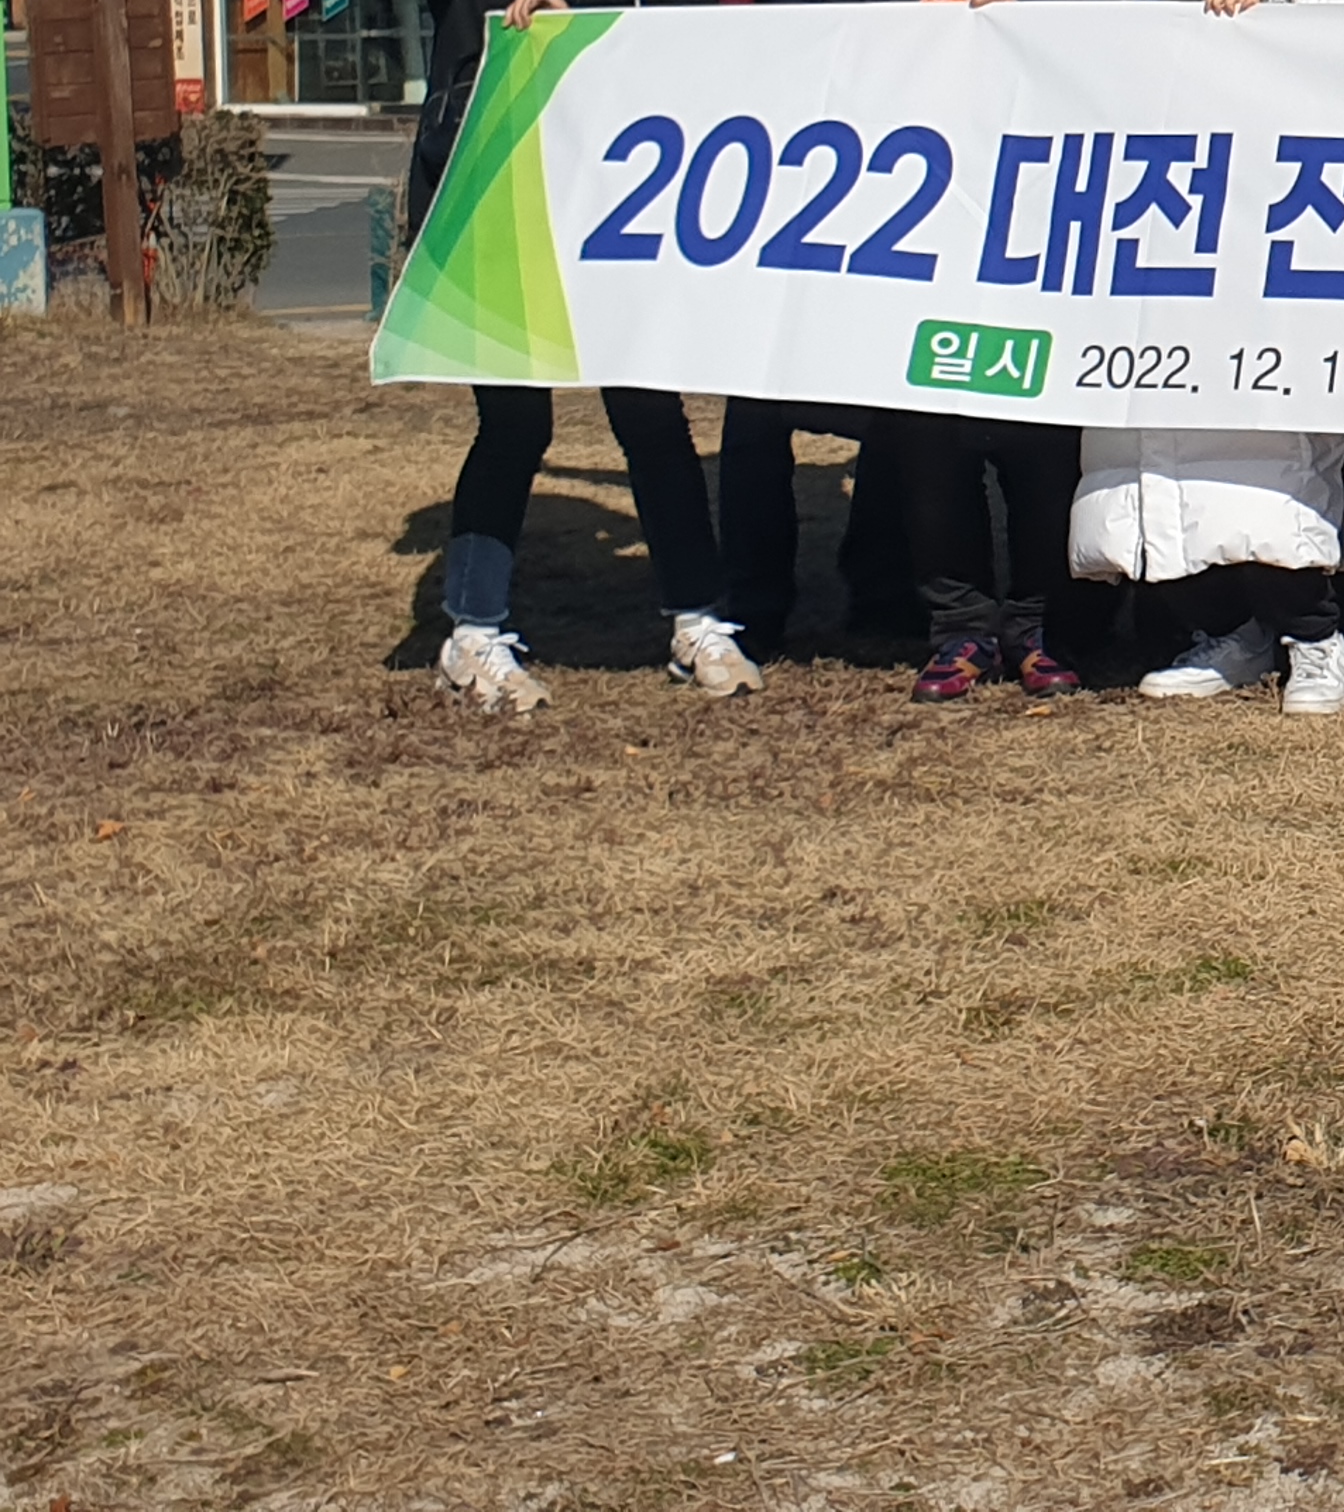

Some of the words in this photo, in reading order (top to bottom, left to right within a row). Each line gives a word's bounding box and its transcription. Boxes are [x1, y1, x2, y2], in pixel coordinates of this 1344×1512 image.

[580, 115, 953, 283] 2022
[976, 132, 1234, 297] 대전
[929, 330, 1041, 390] 일시
[1076, 344, 1199, 394] 2022.
[1229, 347, 1292, 397] 12.
